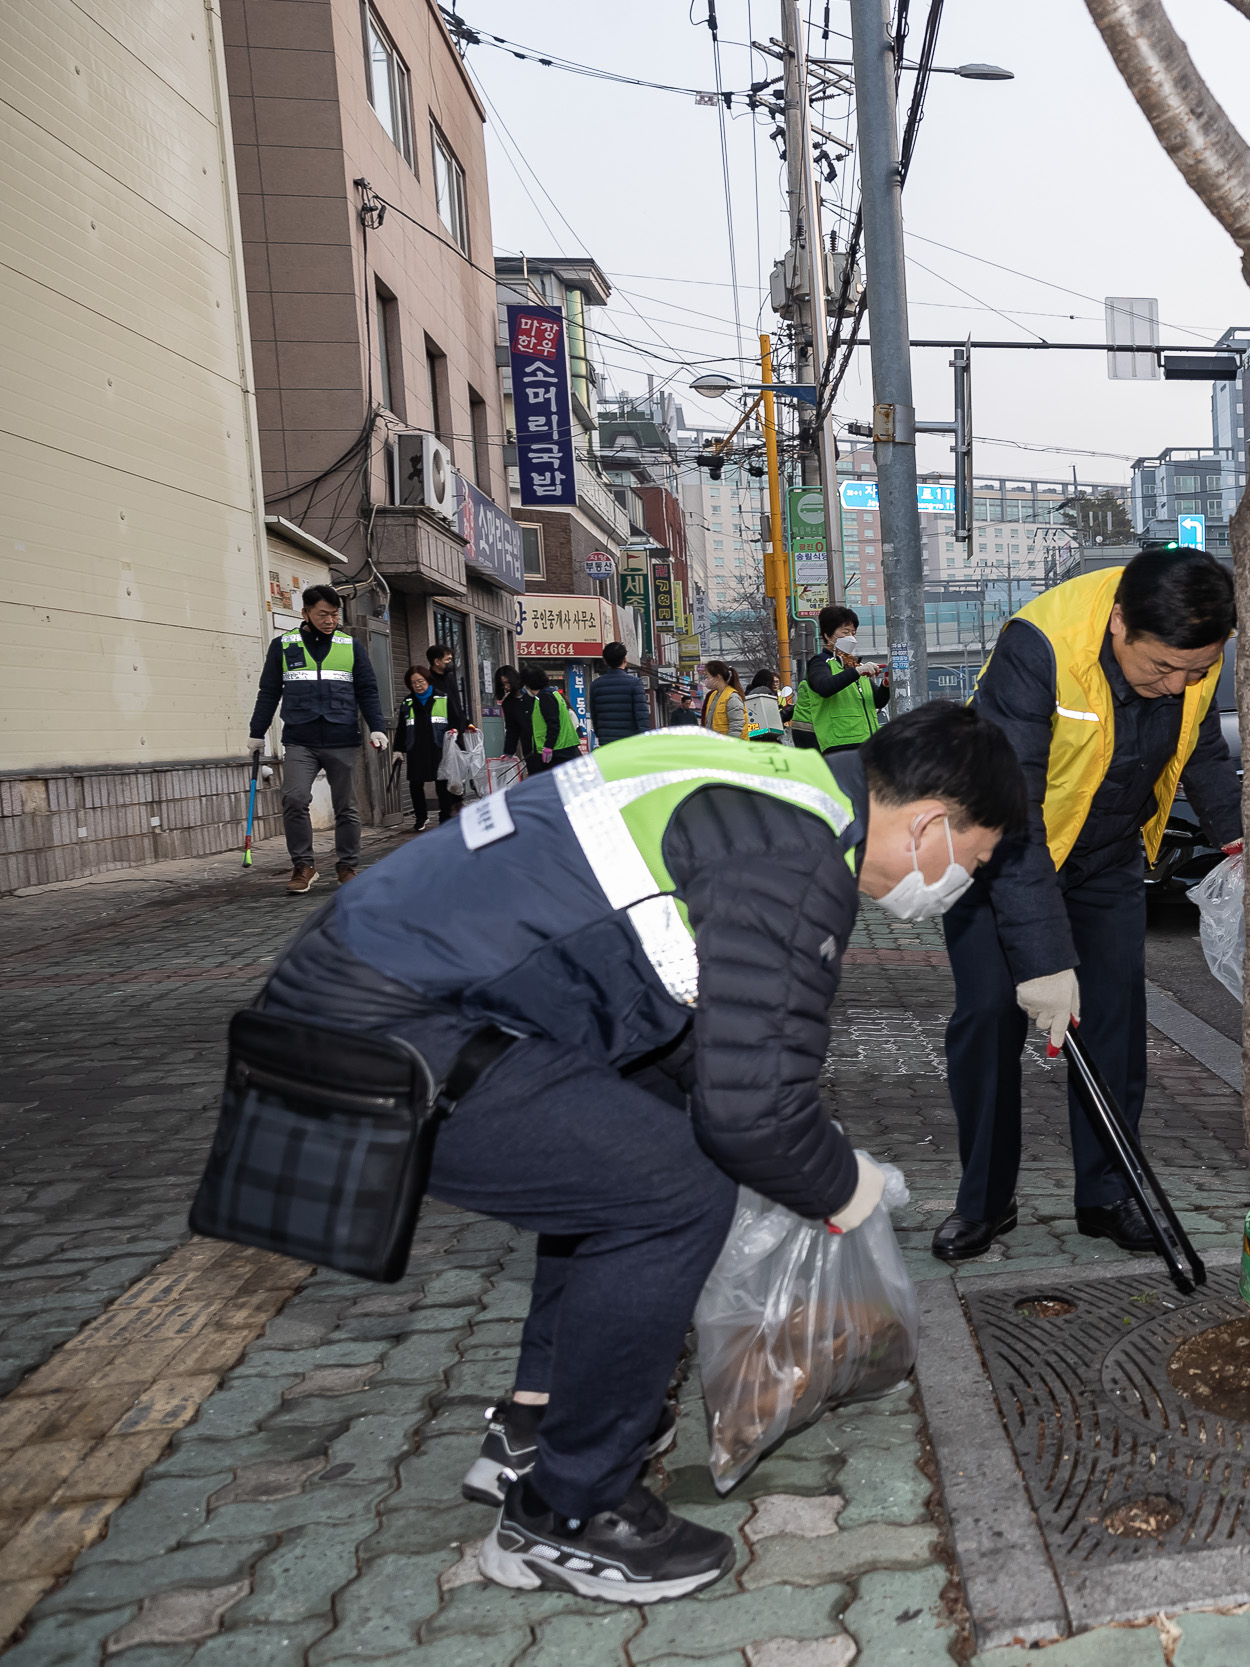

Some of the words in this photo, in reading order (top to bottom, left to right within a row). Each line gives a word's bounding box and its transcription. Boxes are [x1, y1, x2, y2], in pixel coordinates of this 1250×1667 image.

[523, 361, 566, 496] 소머리국밥
[586, 562, 612, 572] 부동산
[573, 610, 597, 630] 사무소
[517, 643, 575, 655] 54-4664
